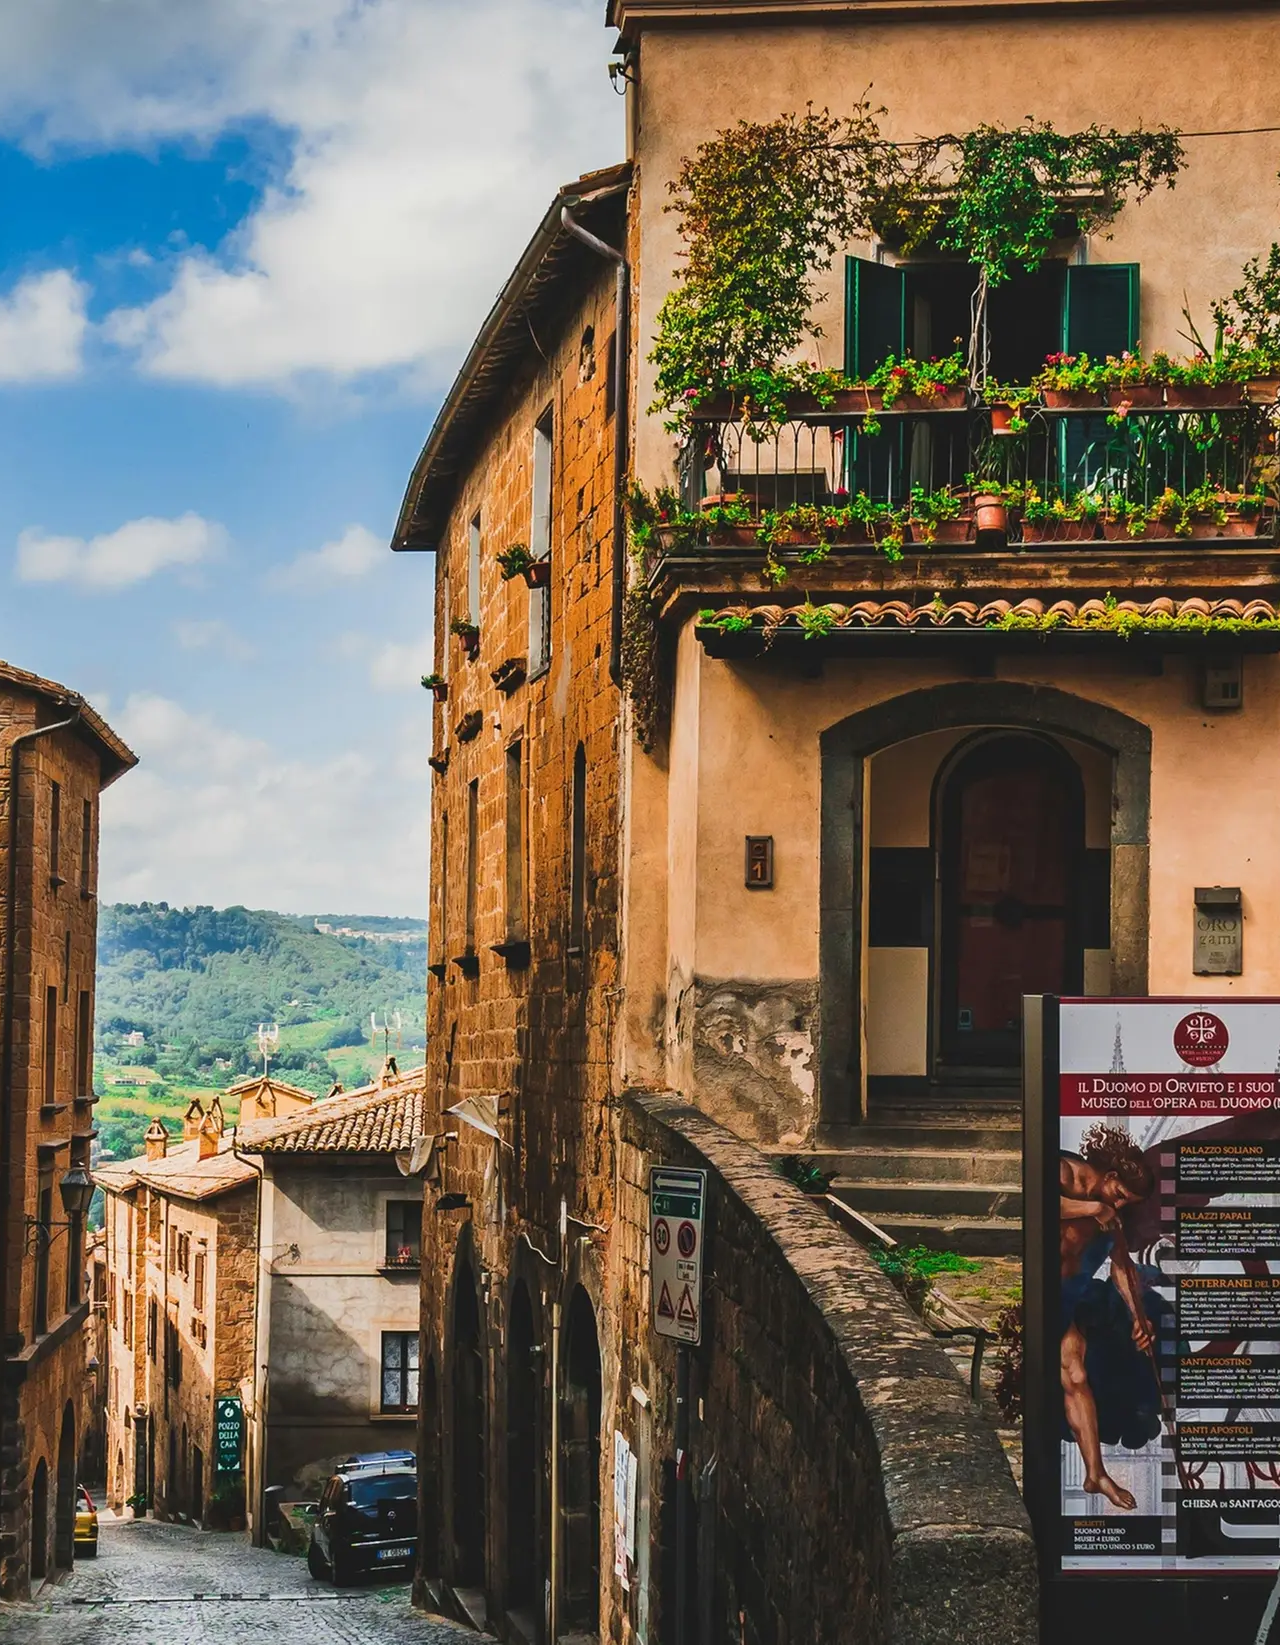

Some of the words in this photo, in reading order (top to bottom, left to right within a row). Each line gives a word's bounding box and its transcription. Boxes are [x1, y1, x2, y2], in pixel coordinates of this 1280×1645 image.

[1198, 918, 1237, 932] ORO
[1079, 1082, 1089, 1094] IL
[1093, 1079, 1145, 1094] DUOMO
[1150, 1082, 1161, 1094] DI
[1166, 1079, 1224, 1094] ORVIETO
[1228, 1082, 1234, 1094] E
[1246, 1082, 1274, 1094] SUOI
[1081, 1097, 1127, 1109] MUSEO
[1129, 1097, 1198, 1109] DELL'OPERA
[1200, 1101, 1218, 1109] DEL
[1220, 1097, 1272, 1109] DUOMO
[1180, 1146, 1222, 1154] PALAZZO
[1223, 1146, 1264, 1154] SOLIANO
[1180, 1212, 1218, 1220] PALAZZI
[1220, 1212, 1252, 1220] PAPALI
[1180, 1279, 1252, 1288] SOTTERRANEI
[1180, 1358, 1252, 1366] SANT'AGOSTINO
[218, 1422, 240, 1430] POZZO
[1182, 1498, 1218, 1508] CHIESA
